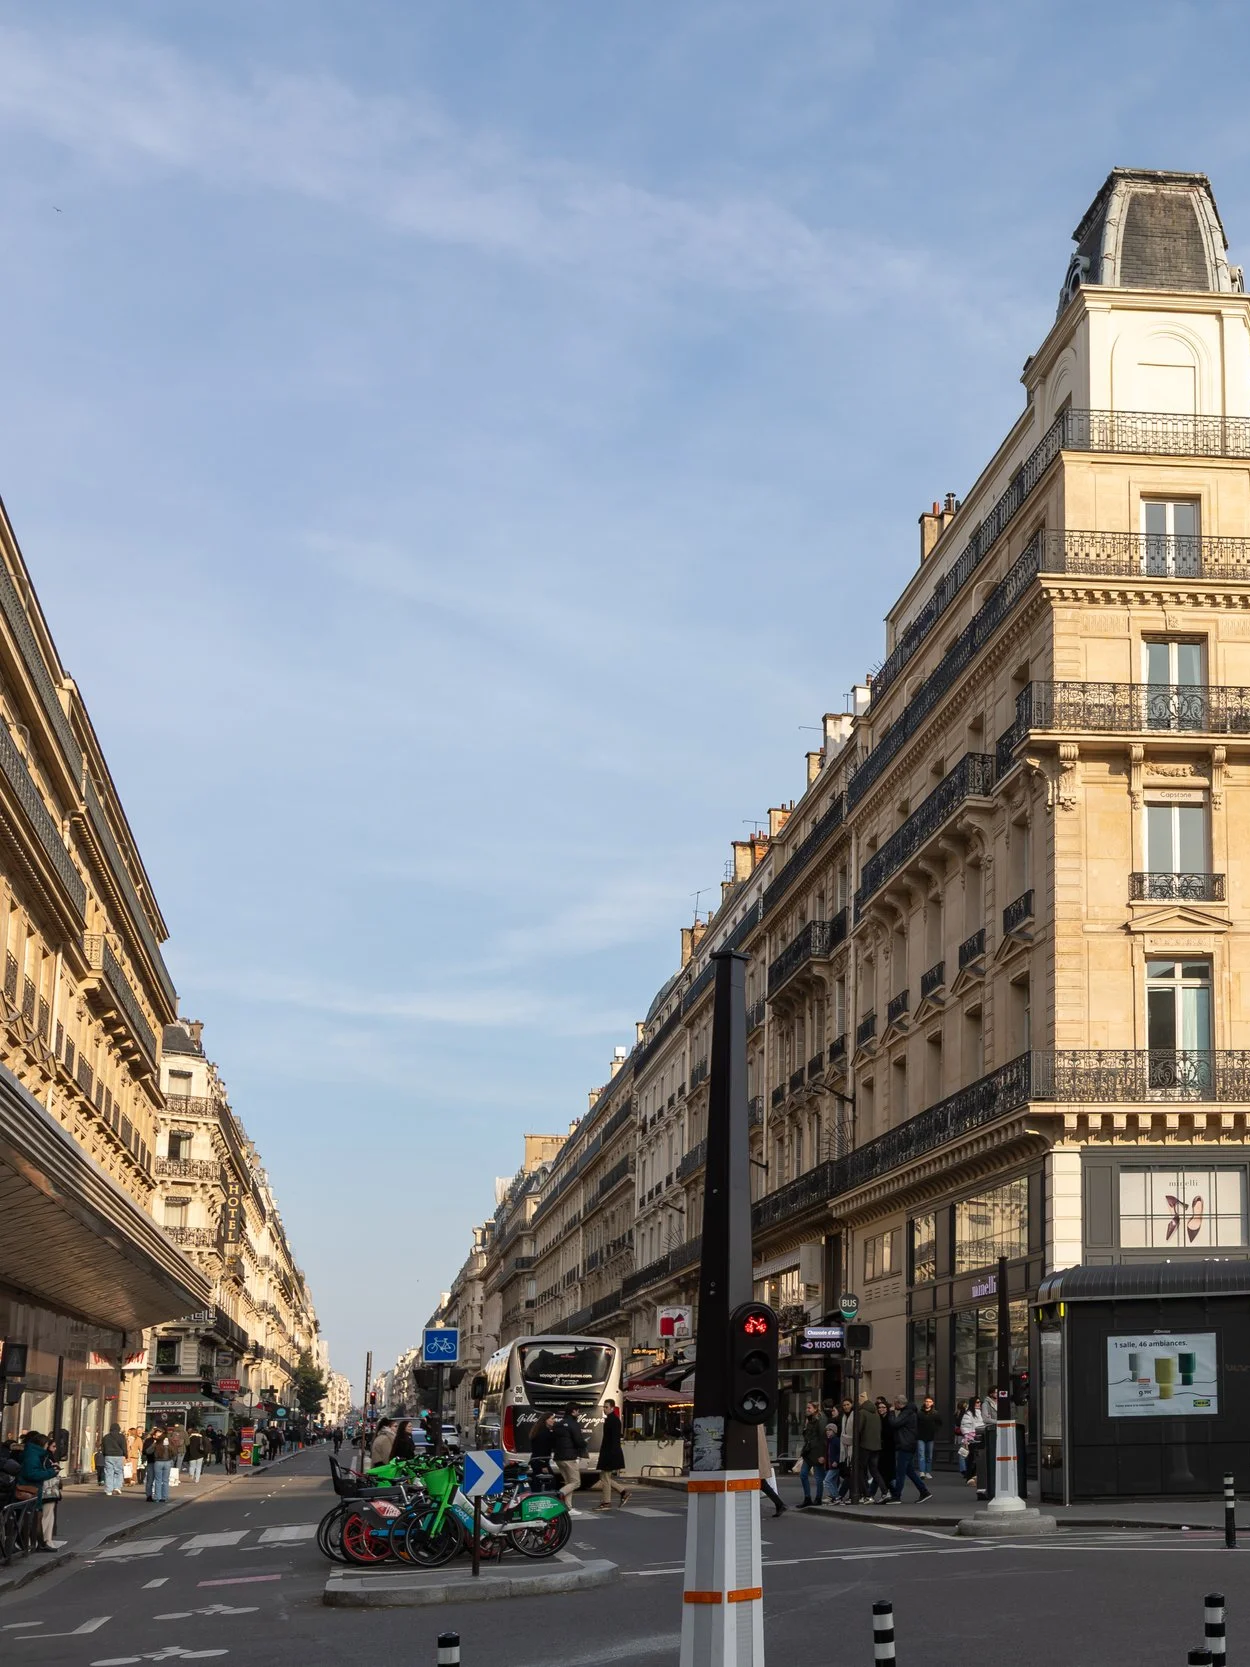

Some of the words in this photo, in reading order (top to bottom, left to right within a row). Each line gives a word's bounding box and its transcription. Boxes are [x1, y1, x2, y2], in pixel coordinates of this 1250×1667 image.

[1160, 791, 1192, 799] Capstone
[228, 1184, 239, 1241] HOTEL
[971, 1275, 997, 1298] minelli
[841, 1299, 857, 1307] BUS
[814, 1341, 841, 1349] KISORO
[1119, 1341, 1138, 1349] salle,
[1138, 1340, 1148, 1348] 46
[1148, 1339, 1188, 1348] ambiances.
[515, 1386, 523, 1394] 90
[576, 1413, 605, 1428] Voyage
